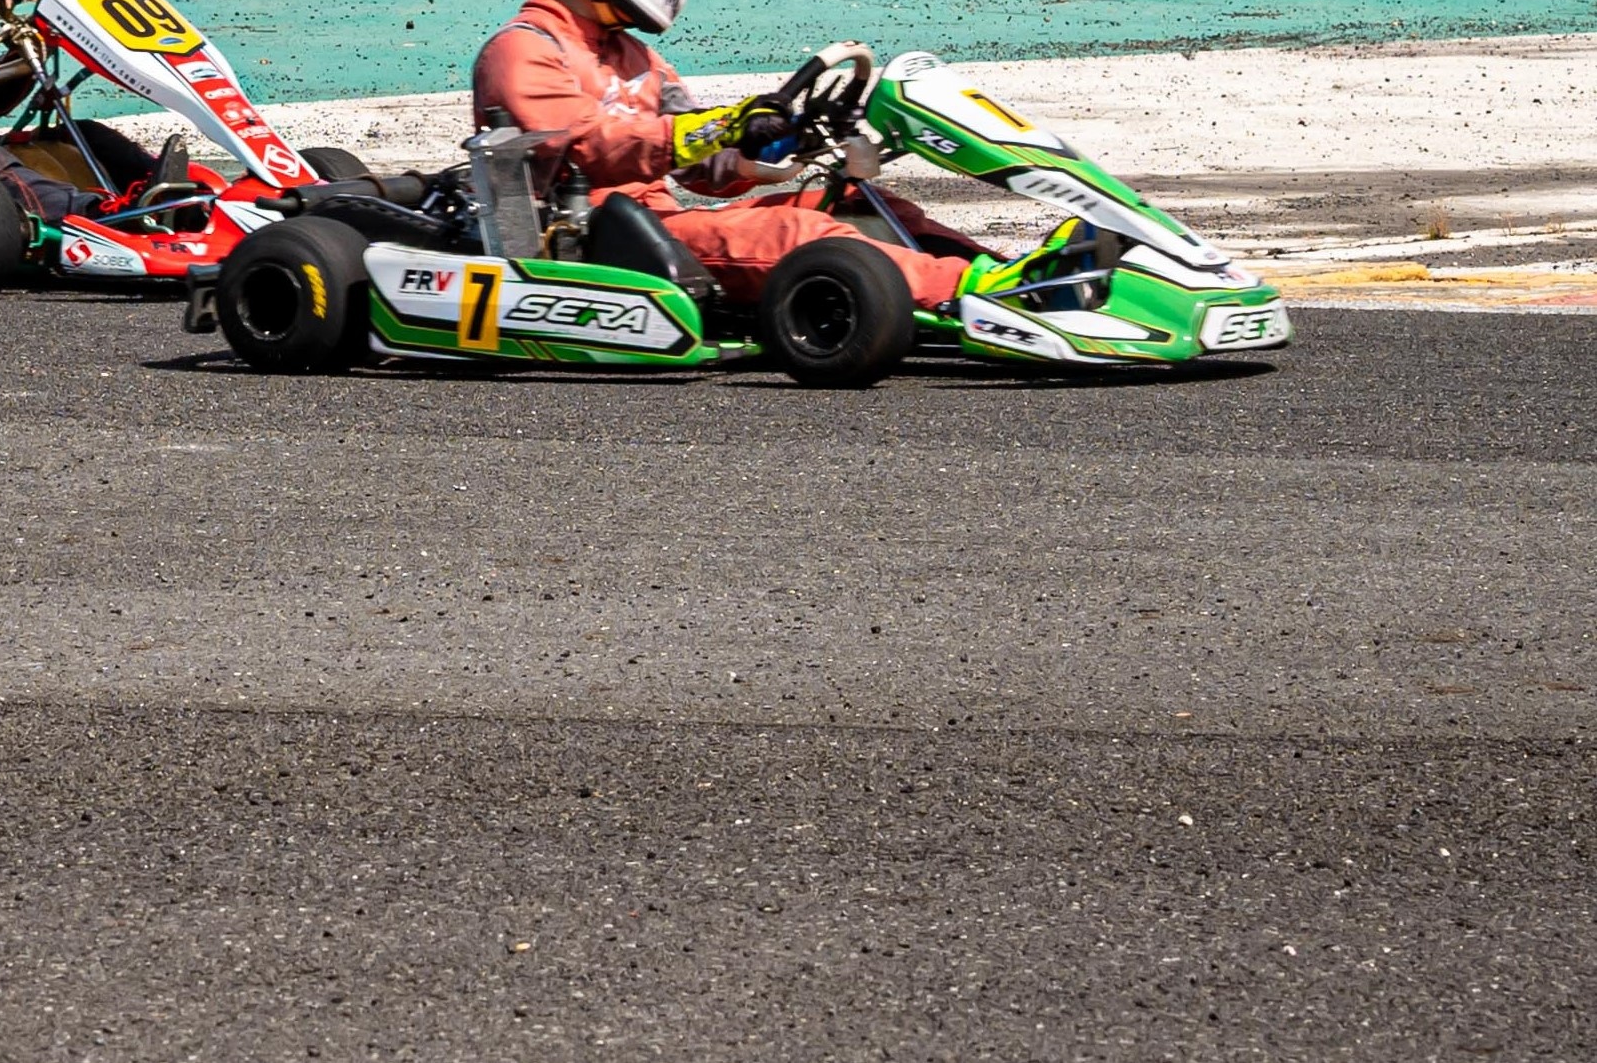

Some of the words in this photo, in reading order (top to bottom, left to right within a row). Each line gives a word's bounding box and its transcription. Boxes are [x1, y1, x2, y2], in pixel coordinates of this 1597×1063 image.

[916, 129, 960, 155] XS
[92, 254, 134, 268] SOBEK
[153, 242, 208, 256] FRV
[399, 269, 456, 292] FRV
[467, 271, 496, 342] 7
[505, 293, 651, 335] SERA
